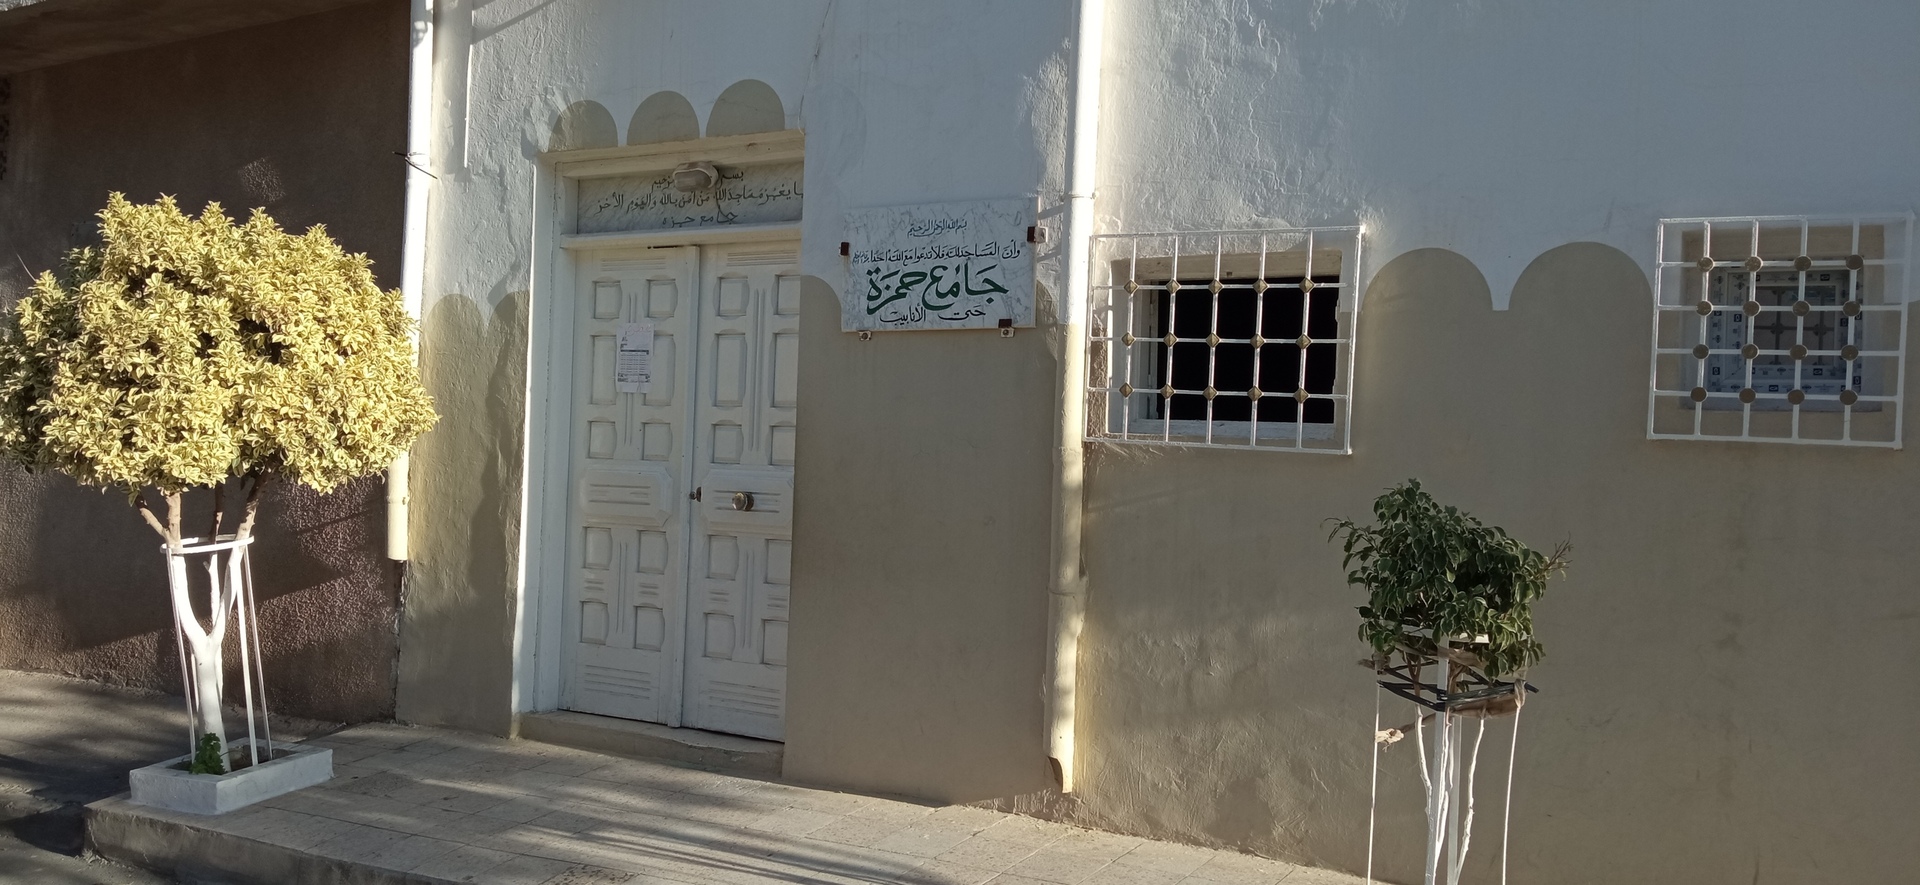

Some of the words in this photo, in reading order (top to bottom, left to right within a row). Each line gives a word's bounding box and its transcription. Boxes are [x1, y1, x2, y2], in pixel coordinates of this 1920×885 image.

[650, 175, 675, 194] رحيم
[717, 171, 744, 190] بسم
[659, 192, 678, 208] بالله
[696, 190, 710, 206] من
[700, 210, 738, 227] جامع
[913, 218, 948, 238] الرحمن
[947, 218, 959, 233] الله
[955, 218, 967, 235] بسم
[907, 218, 933, 239] الرحيم
[866, 266, 928, 315] حمزة
[922, 262, 1009, 311] جامع
[880, 303, 927, 326] الأنابيب
